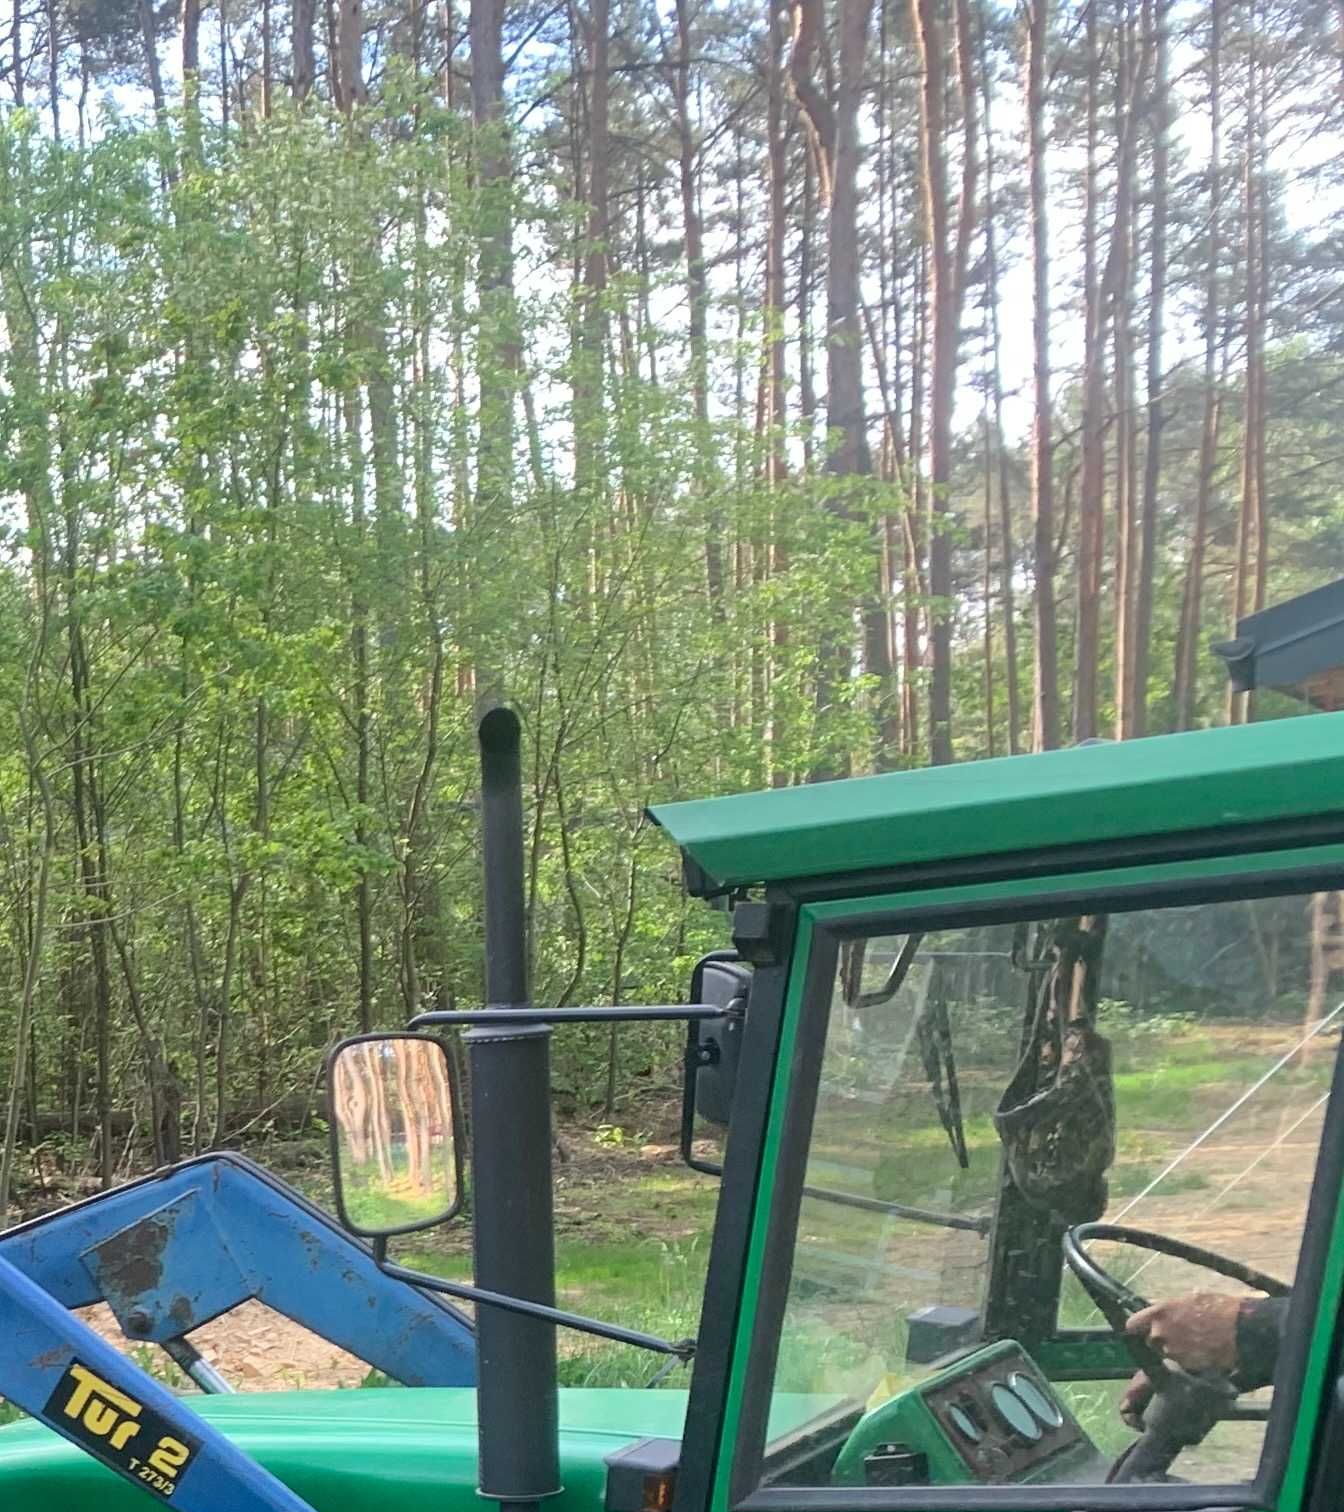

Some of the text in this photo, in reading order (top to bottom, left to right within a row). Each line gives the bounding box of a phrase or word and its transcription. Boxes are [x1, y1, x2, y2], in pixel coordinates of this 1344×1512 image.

[64, 1363, 190, 1478] Tur 2
[127, 1458, 175, 1496] T 273/3
